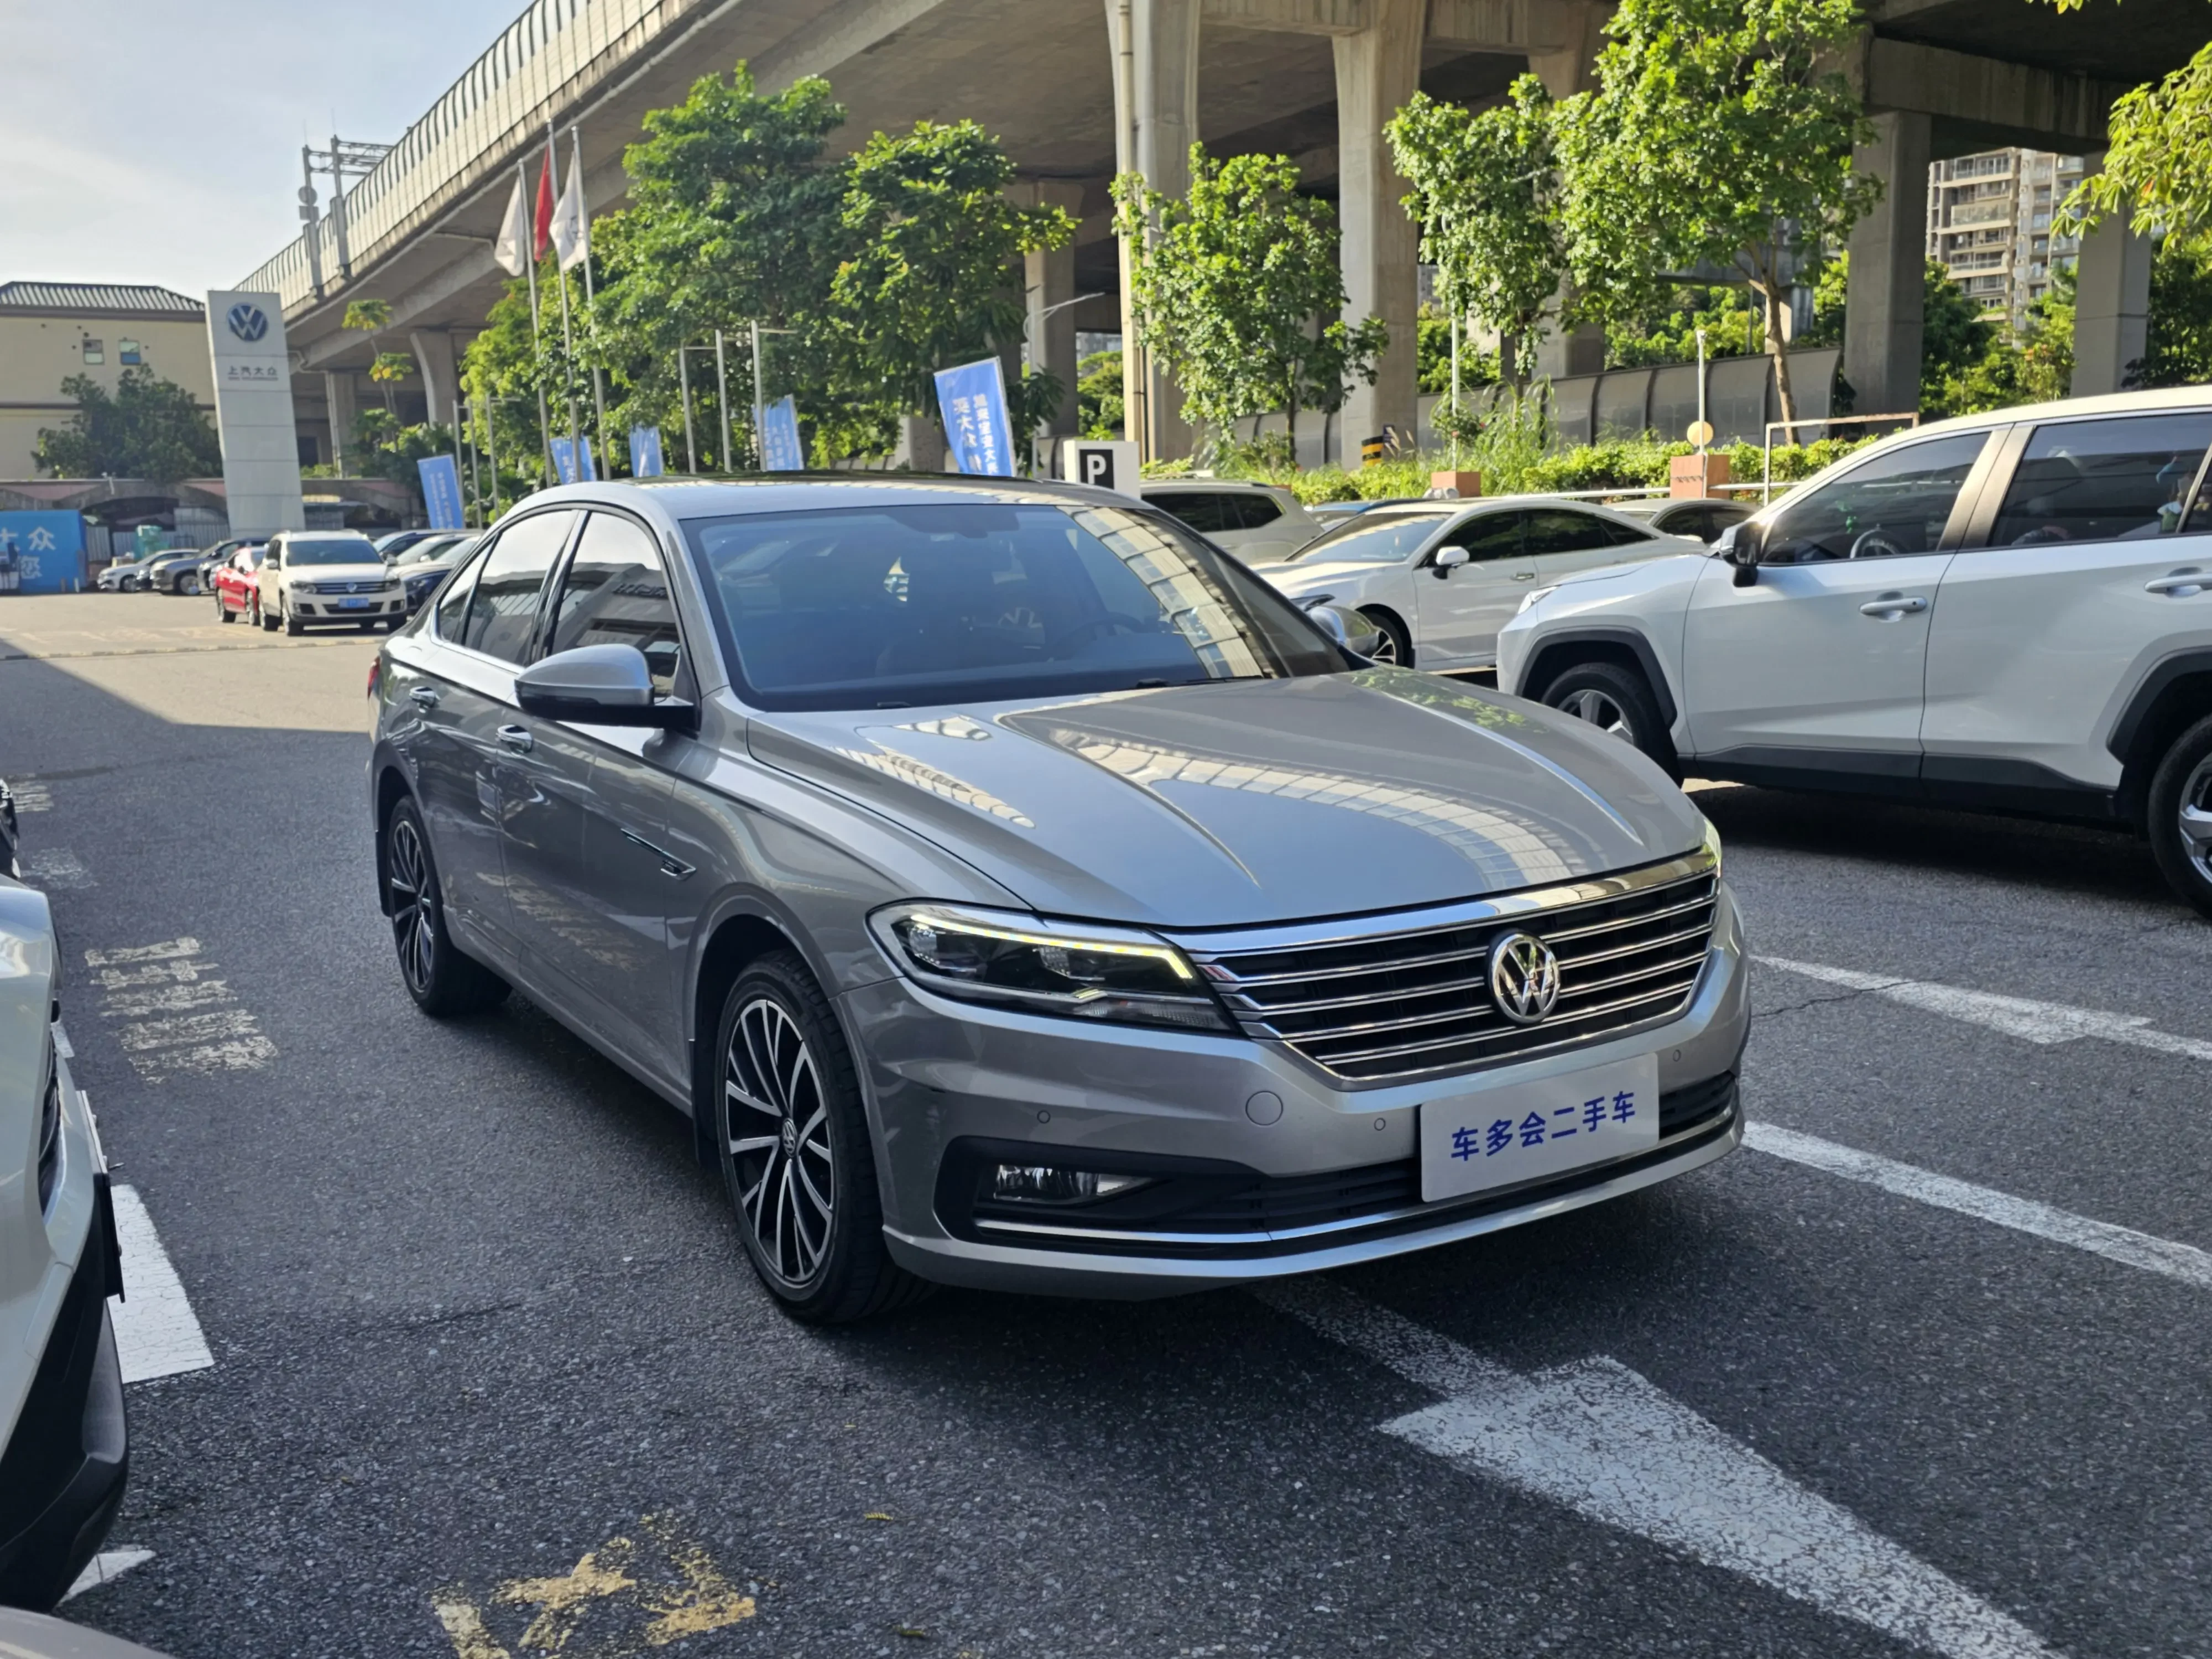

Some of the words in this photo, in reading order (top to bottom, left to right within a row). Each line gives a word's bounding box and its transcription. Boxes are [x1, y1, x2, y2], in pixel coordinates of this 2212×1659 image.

[1087, 454, 1107, 485] P
[1451, 1091, 1635, 1161] 车多会二手车
